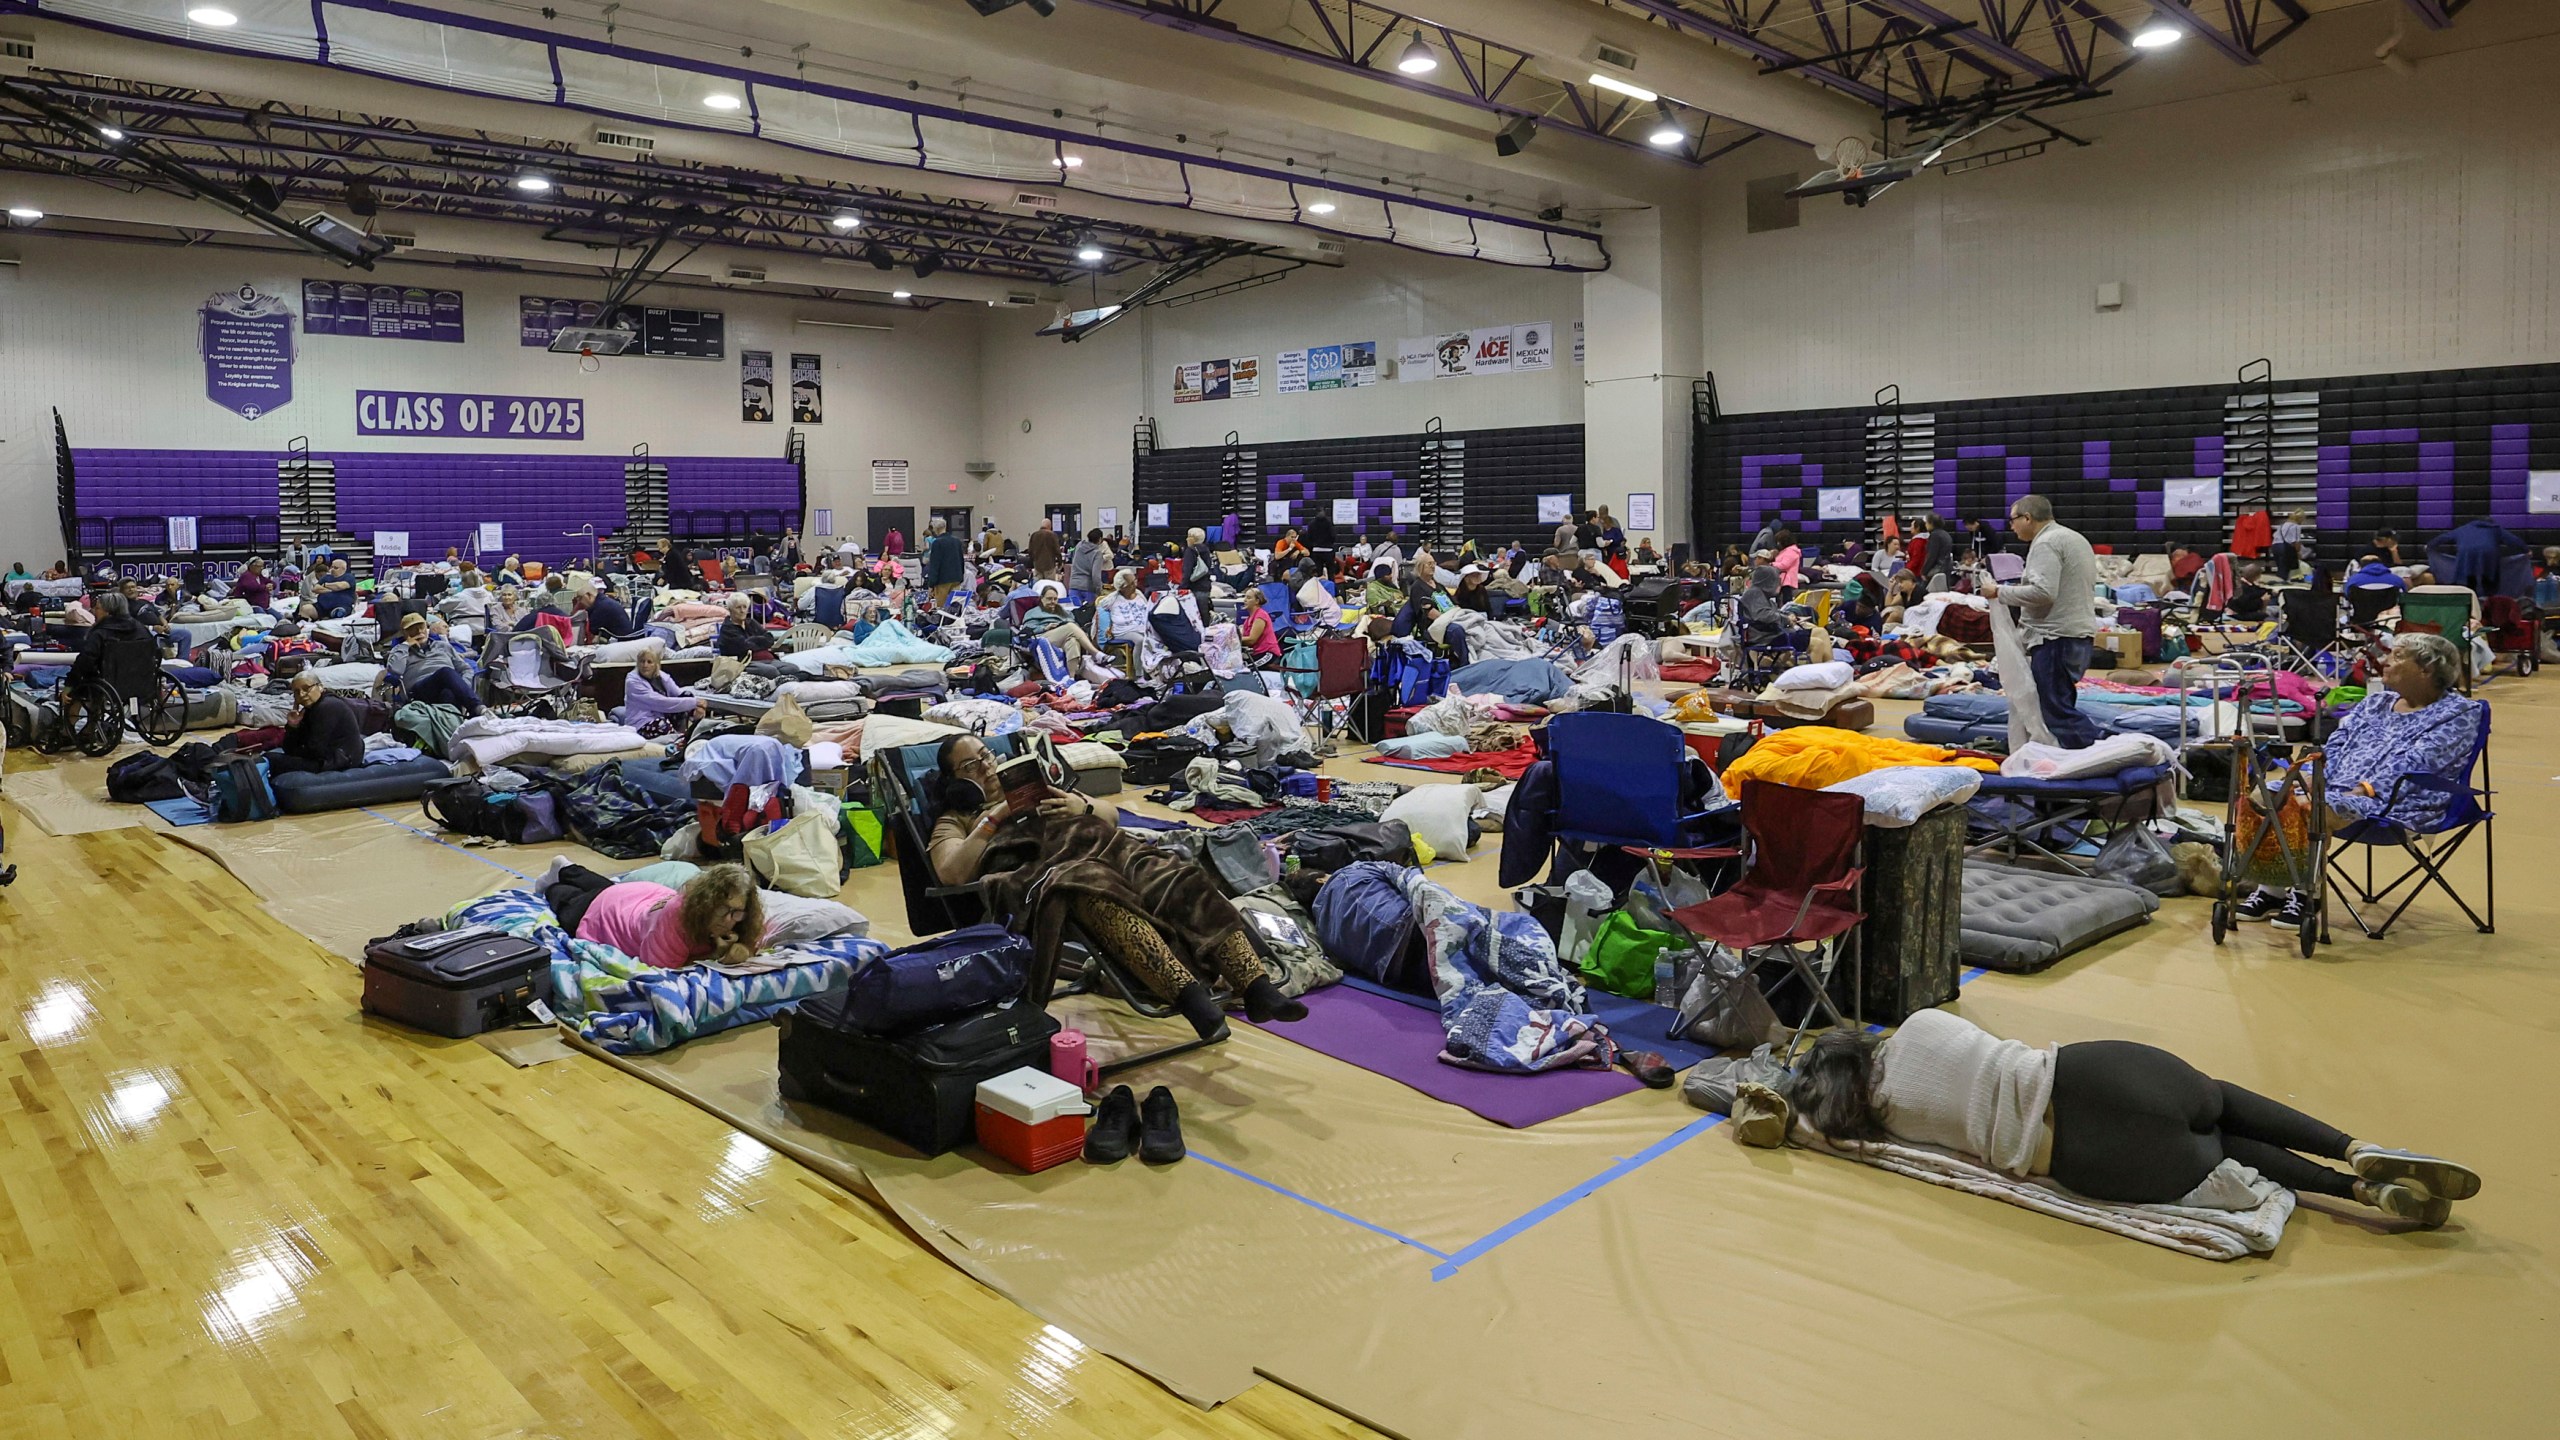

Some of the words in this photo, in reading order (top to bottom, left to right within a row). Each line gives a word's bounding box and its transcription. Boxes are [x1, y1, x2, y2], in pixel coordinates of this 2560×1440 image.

[1475, 340, 1509, 359] ACE
[1516, 348, 1549, 357] MEXICAN
[1311, 352, 1338, 370] SOD
[1475, 358, 1509, 366] Hardware
[360, 395, 444, 431] CLASS
[460, 399, 495, 433] OF
[508, 401, 581, 434] 2025
[2180, 500, 2202, 508] Right
